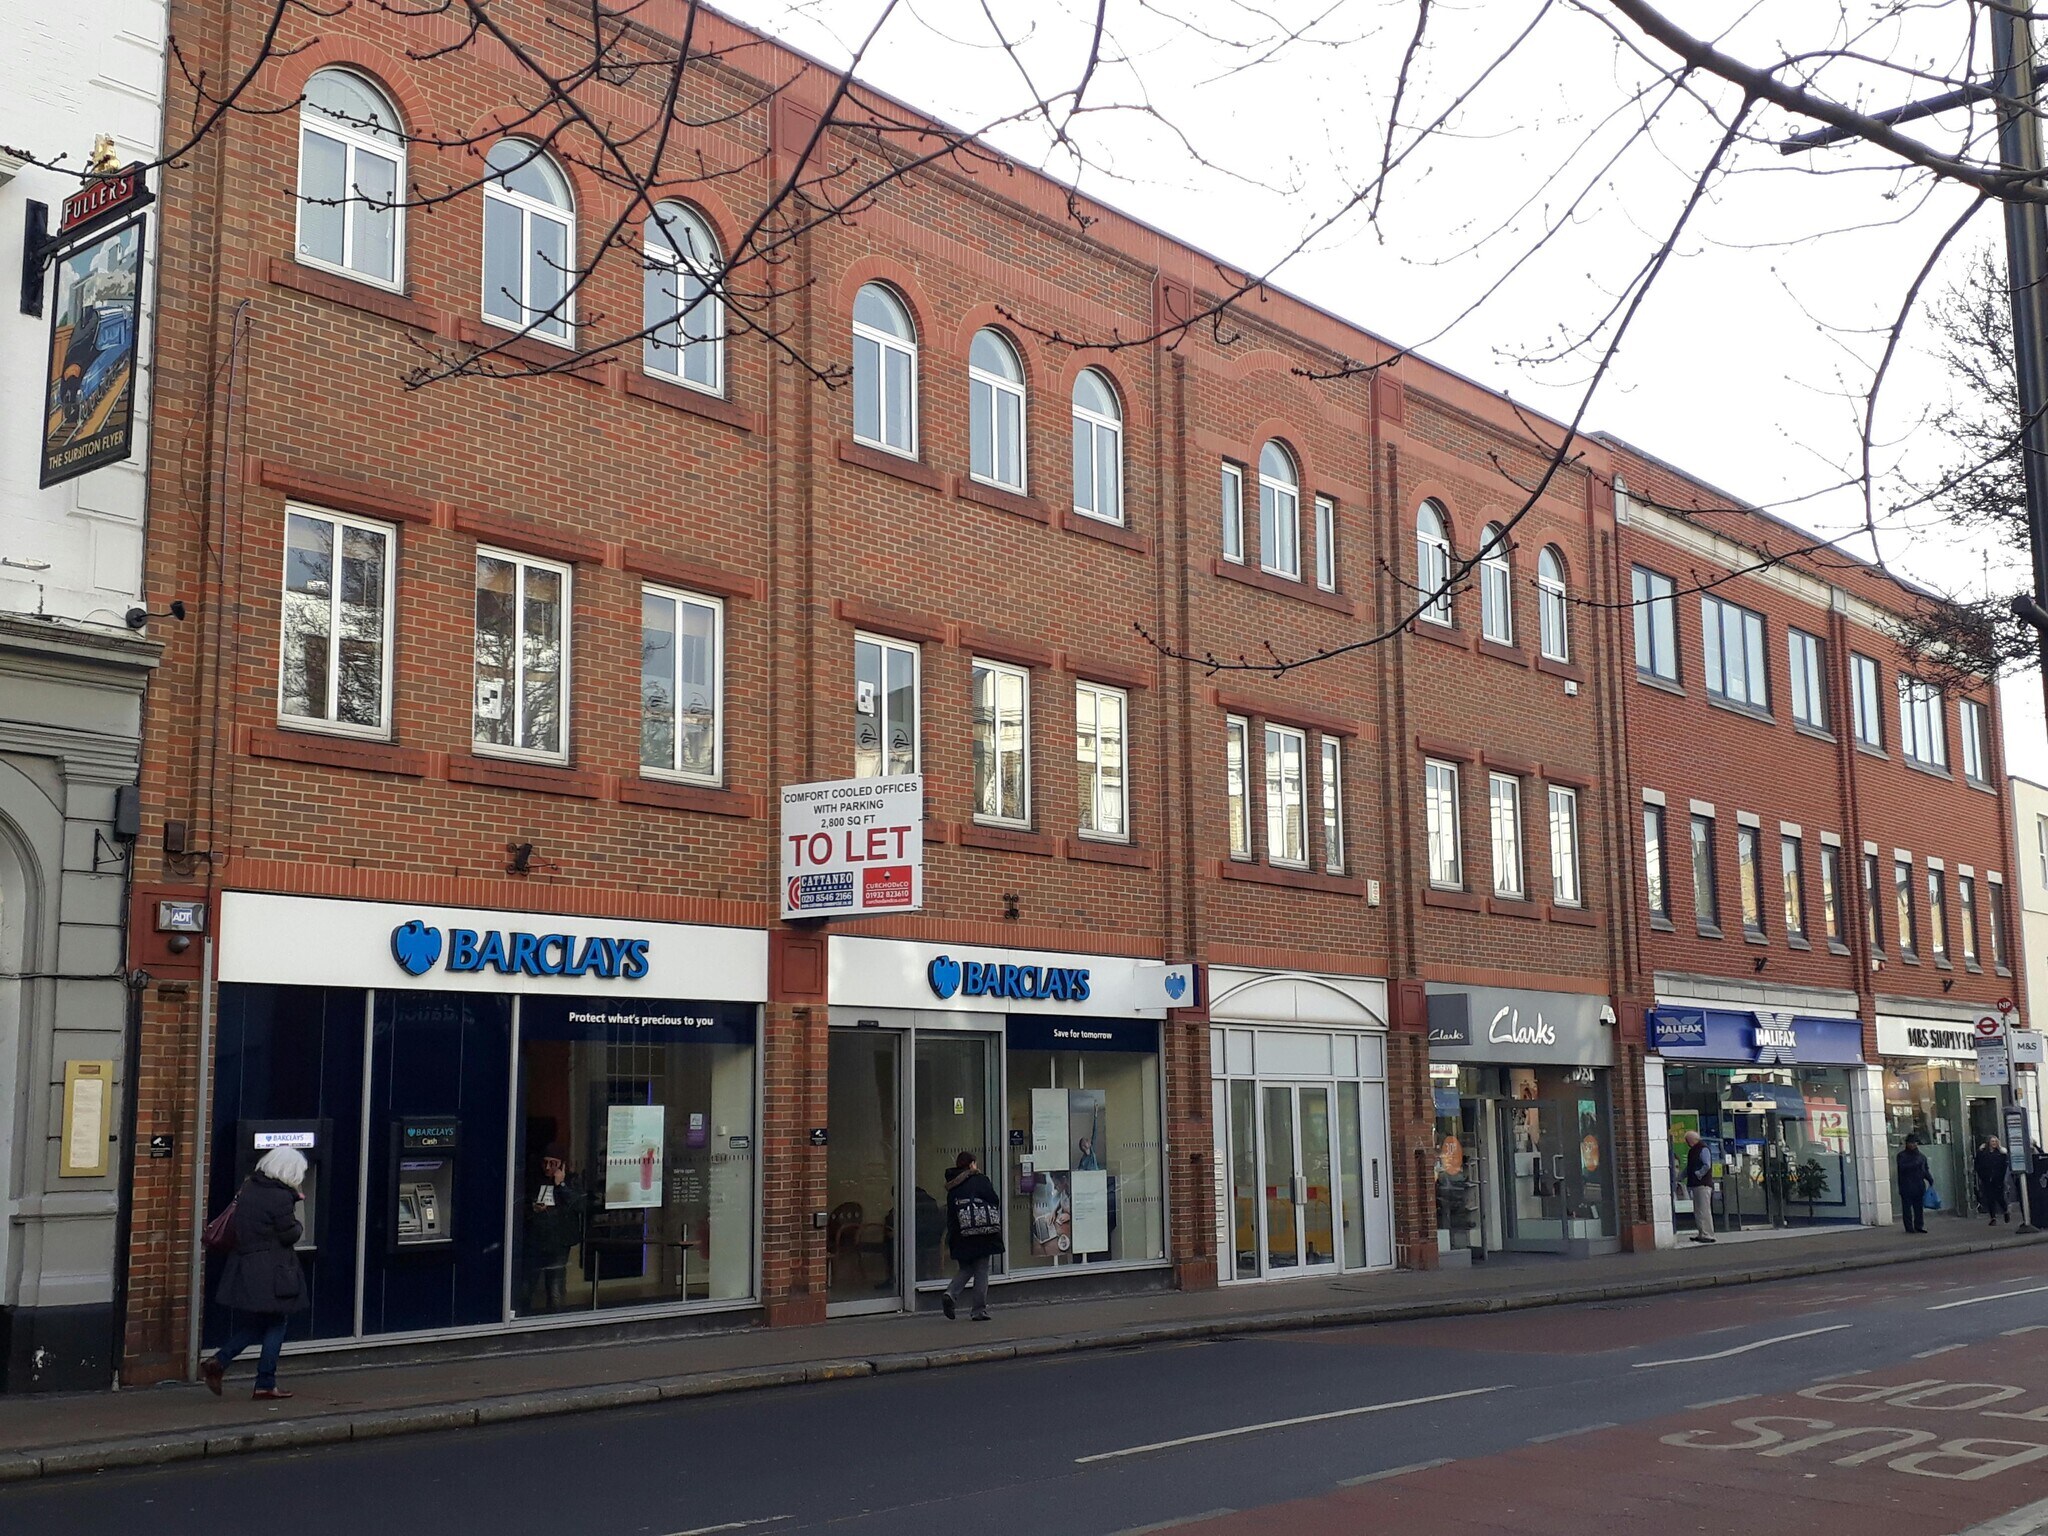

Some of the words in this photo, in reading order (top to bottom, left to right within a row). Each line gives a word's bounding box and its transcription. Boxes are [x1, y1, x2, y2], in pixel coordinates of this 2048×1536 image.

[48, 452, 63, 470] THE
[63, 440, 100, 466] SURBITON
[102, 430, 124, 453] FLYER
[784, 789, 829, 803] COMFORT
[832, 786, 872, 799] COOLED
[875, 782, 917, 795] OFFICES
[814, 803, 838, 814] WITH
[840, 800, 884, 812] PARKING
[821, 817, 845, 829] 2,800
[847, 816, 861, 826] SQ
[863, 814, 876, 824] FT
[789, 832, 833, 867] TO
[846, 826, 912, 862] LET
[801, 873, 853, 887] CATTANEO
[801, 894, 814, 903] 020
[816, 893, 834, 902] 8546
[835, 892, 852, 901] 2166
[865, 891, 884, 899] 01932
[886, 890, 909, 898] 823610
[173, 912, 192, 922] ADT
[446, 928, 649, 979] BARCLAYS
[961, 961, 1090, 1001] BARCLAYS
[1998, 1001, 2011, 1009] NP
[569, 1012, 605, 1023] Protect
[608, 1013, 640, 1024] what's
[641, 1015, 682, 1026] precious
[684, 1016, 694, 1025] to
[696, 1018, 714, 1027] you
[1489, 1005, 1556, 1045] Clarks
[1053, 1029, 1069, 1038] Save
[1070, 1029, 1080, 1038] for
[1081, 1030, 1113, 1039] tomorrow
[1428, 1029, 1464, 1041] Clarks
[1656, 1024, 1703, 1034] HALIFAX
[1755, 1027, 1797, 1047] HALIFAX
[1907, 1028, 1929, 1048] M&S
[1930, 1029, 1961, 1050] SIMPLY
[1962, 1031, 1976, 1050] FO
[2017, 1042, 2037, 1050] M&S
[273, 1134, 304, 1142] BARCLAYS
[416, 1127, 454, 1136] BARCLAYS
[422, 1137, 438, 1145] Cash
[1659, 1415, 2048, 1481] BUS
